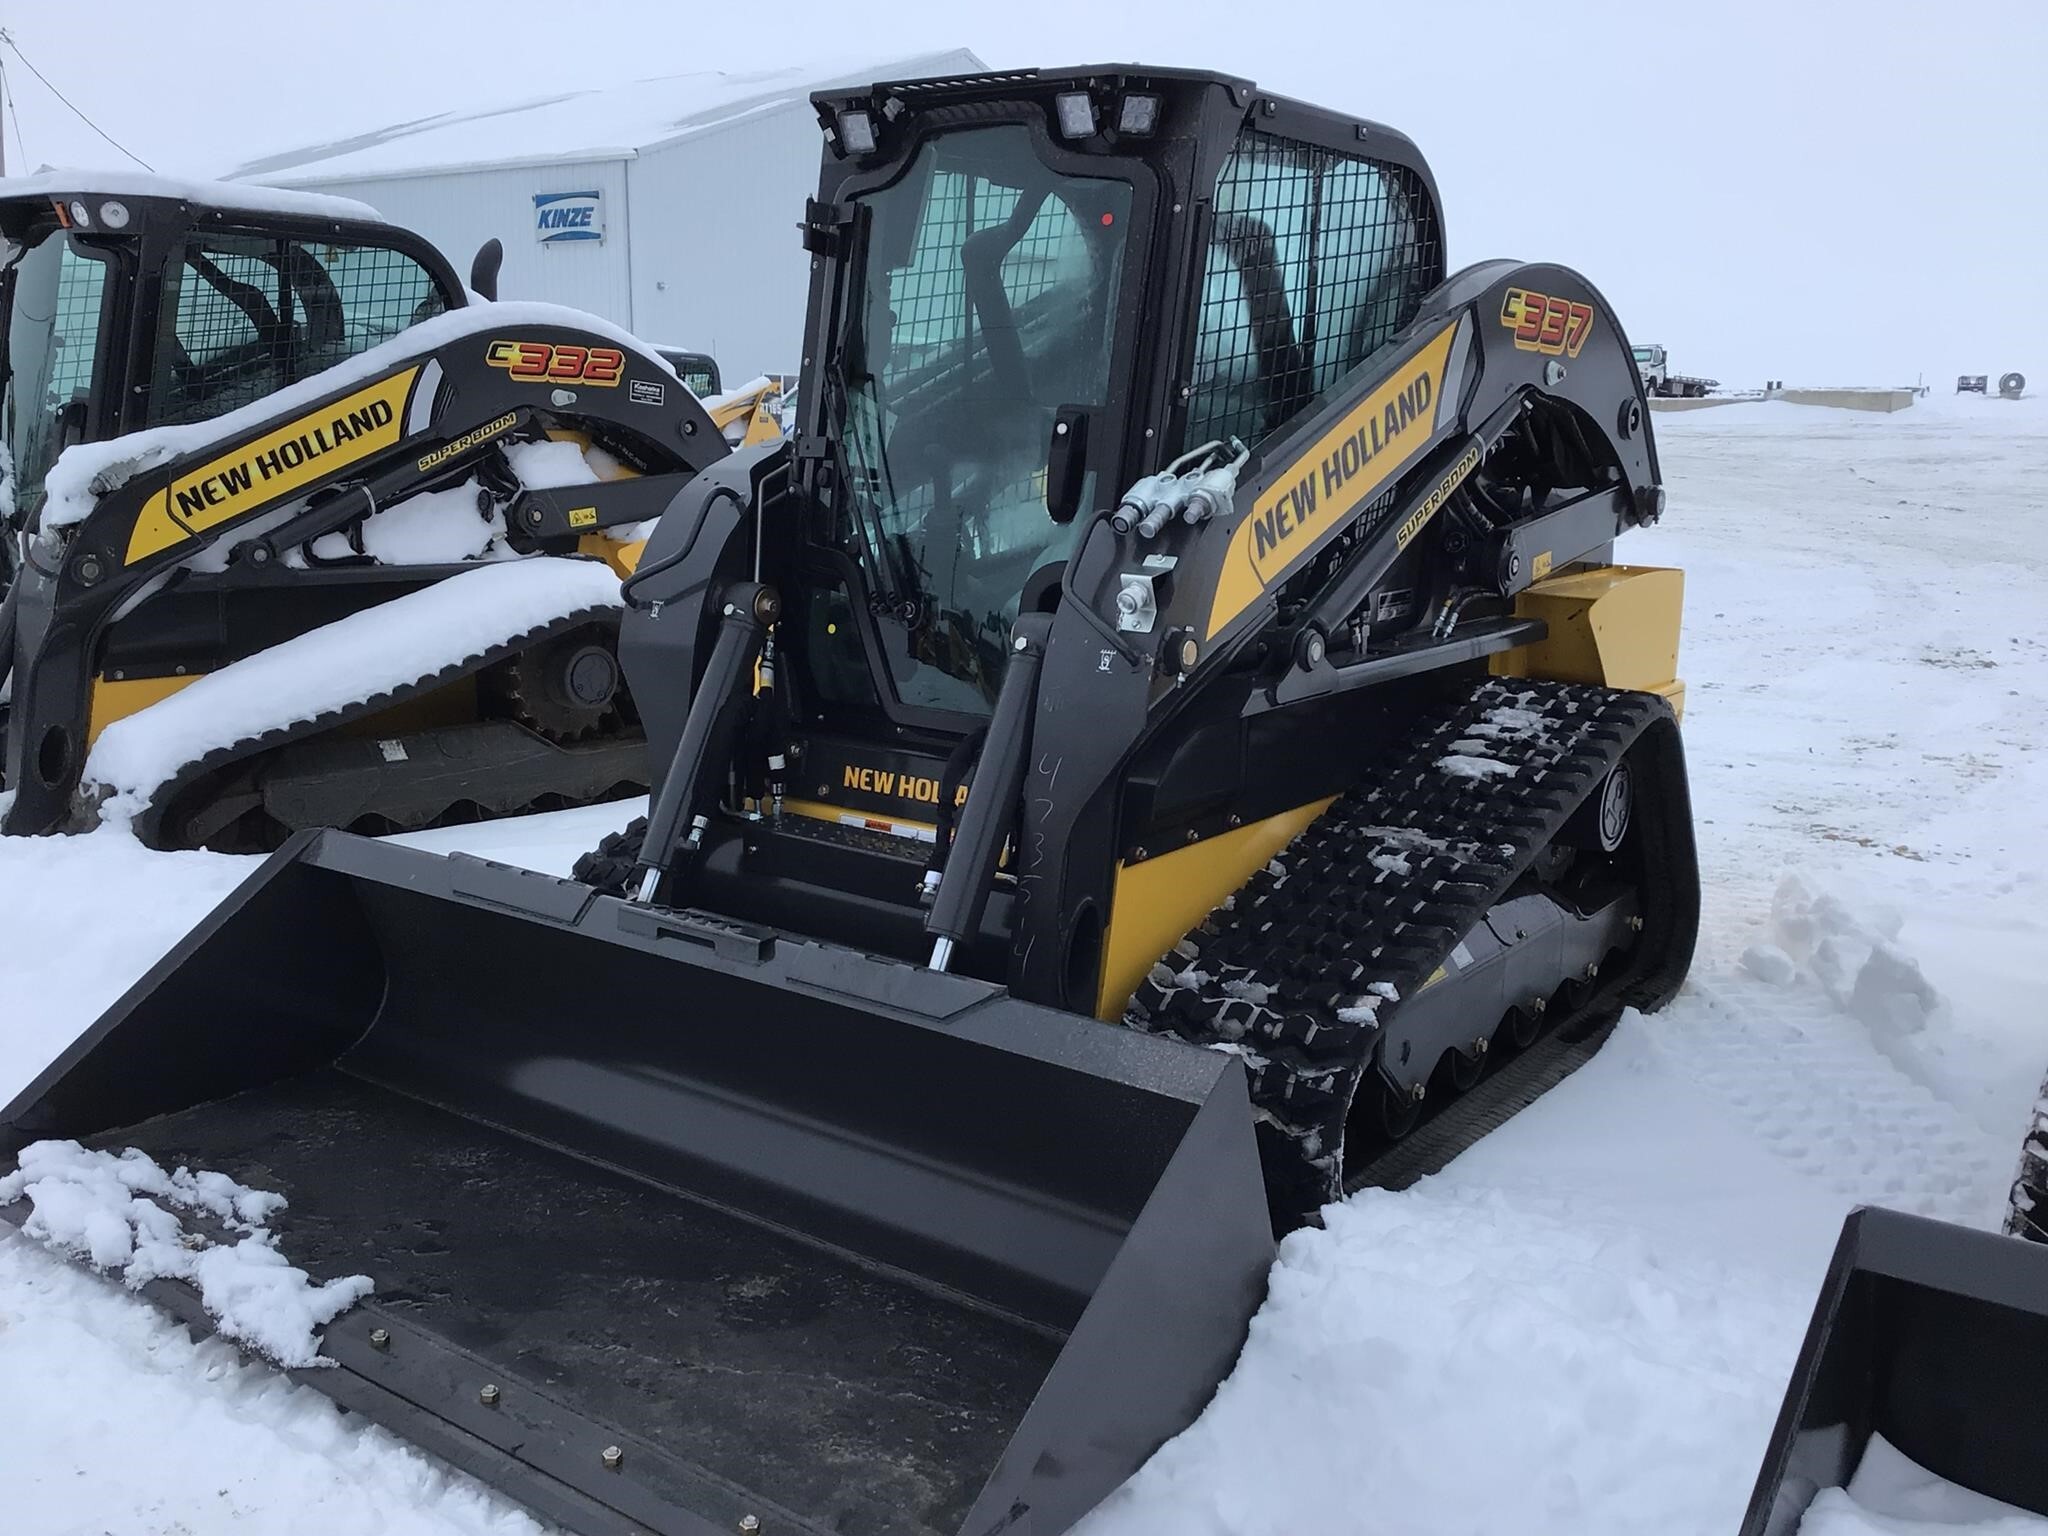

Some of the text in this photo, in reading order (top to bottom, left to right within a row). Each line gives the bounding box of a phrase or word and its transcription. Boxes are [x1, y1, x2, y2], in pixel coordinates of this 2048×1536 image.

[538, 206, 594, 229] KINZE
[1502, 288, 1593, 357] C337
[487, 341, 625, 387] C332
[175, 399, 393, 518] NEW HOLLAND
[418, 412, 516, 471] SUPER BOOM
[1254, 371, 1431, 560] NEW HOLLAND
[1397, 447, 1478, 549] SUPER BOOM
[843, 765, 969, 807] NEW HOLA
